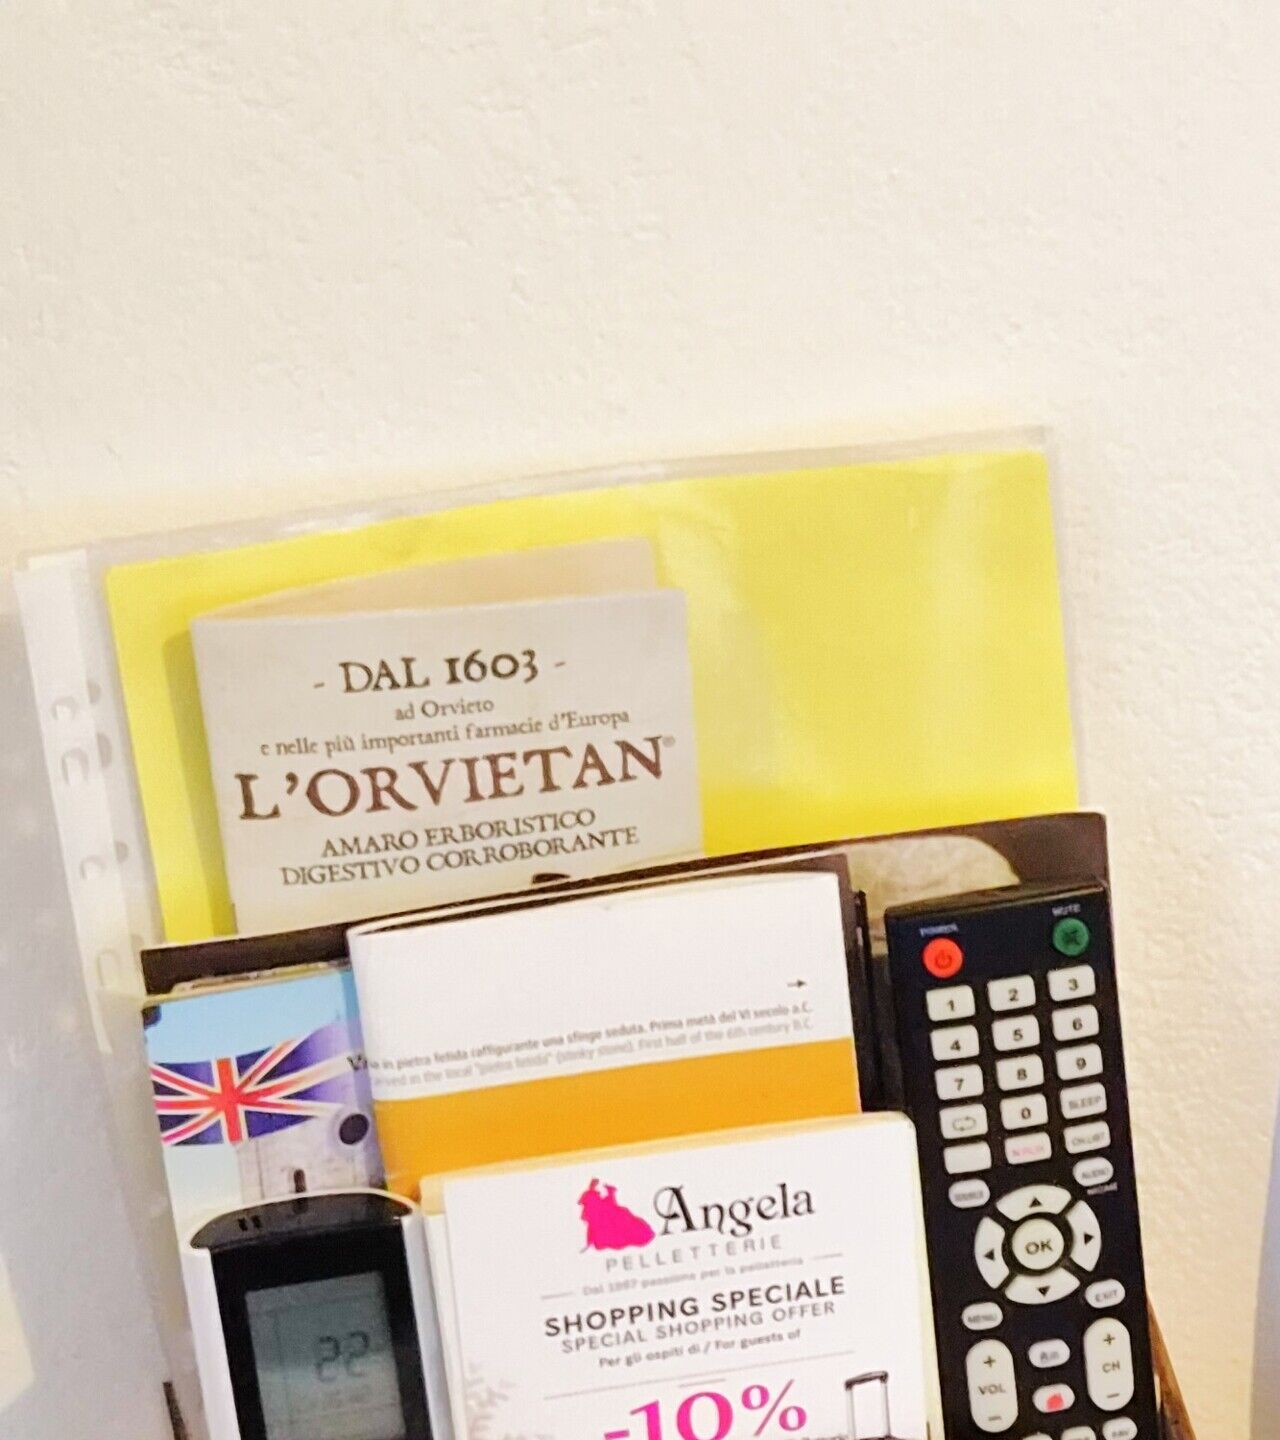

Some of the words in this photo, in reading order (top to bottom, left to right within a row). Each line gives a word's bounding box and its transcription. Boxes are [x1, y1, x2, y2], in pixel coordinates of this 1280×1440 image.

[338, 656, 430, 693] DAL
[444, 649, 539, 685] 1603
[395, 703, 415, 721] ad
[420, 698, 495, 718] Orvieto
[260, 743, 269, 756] e
[275, 736, 318, 756] nelle
[324, 735, 356, 759] più
[361, 724, 460, 755] importanti
[465, 717, 543, 740] farmacie
[548, 711, 630, 731] d'Europa
[322, 830, 419, 858] AMARO
[424, 809, 596, 847] ERBORISTICO
[280, 855, 421, 886] DIGESTIVO
[426, 826, 637, 872] CORROBORANTE
[947, 1000, 956, 1012] 1
[1008, 988, 1019, 1002] 2
[1068, 978, 1079, 992] 3
[949, 1039, 961, 1052] 4
[1013, 1028, 1024, 1041] 5
[1072, 1017, 1083, 1031] 6
[954, 1078, 964, 1091] 7
[1016, 1067, 1028, 1080] 8
[1075, 1057, 1087, 1070] 9
[653, 1182, 816, 1239] Angela
[605, 1234, 781, 1273] PELLETTERIE
[1024, 1239, 1053, 1256] OK
[545, 1297, 699, 1337] SHOPPING
[711, 1275, 844, 1313] SPECIALE
[561, 1329, 647, 1354] SPECIAL
[656, 1311, 764, 1340] SHOPPING
[771, 1300, 835, 1323] OFFER
[315, 1330, 370, 1382] 22
[598, 1357, 621, 1368] Per
[625, 1353, 642, 1367] gli
[645, 1346, 684, 1361] ospiti
[687, 1343, 701, 1355] di
[714, 1339, 736, 1350] For
[740, 1332, 784, 1350] guests
[787, 1328, 801, 1340] of
[1101, 1361, 1121, 1374] CH
[977, 1383, 1006, 1396] VOL
